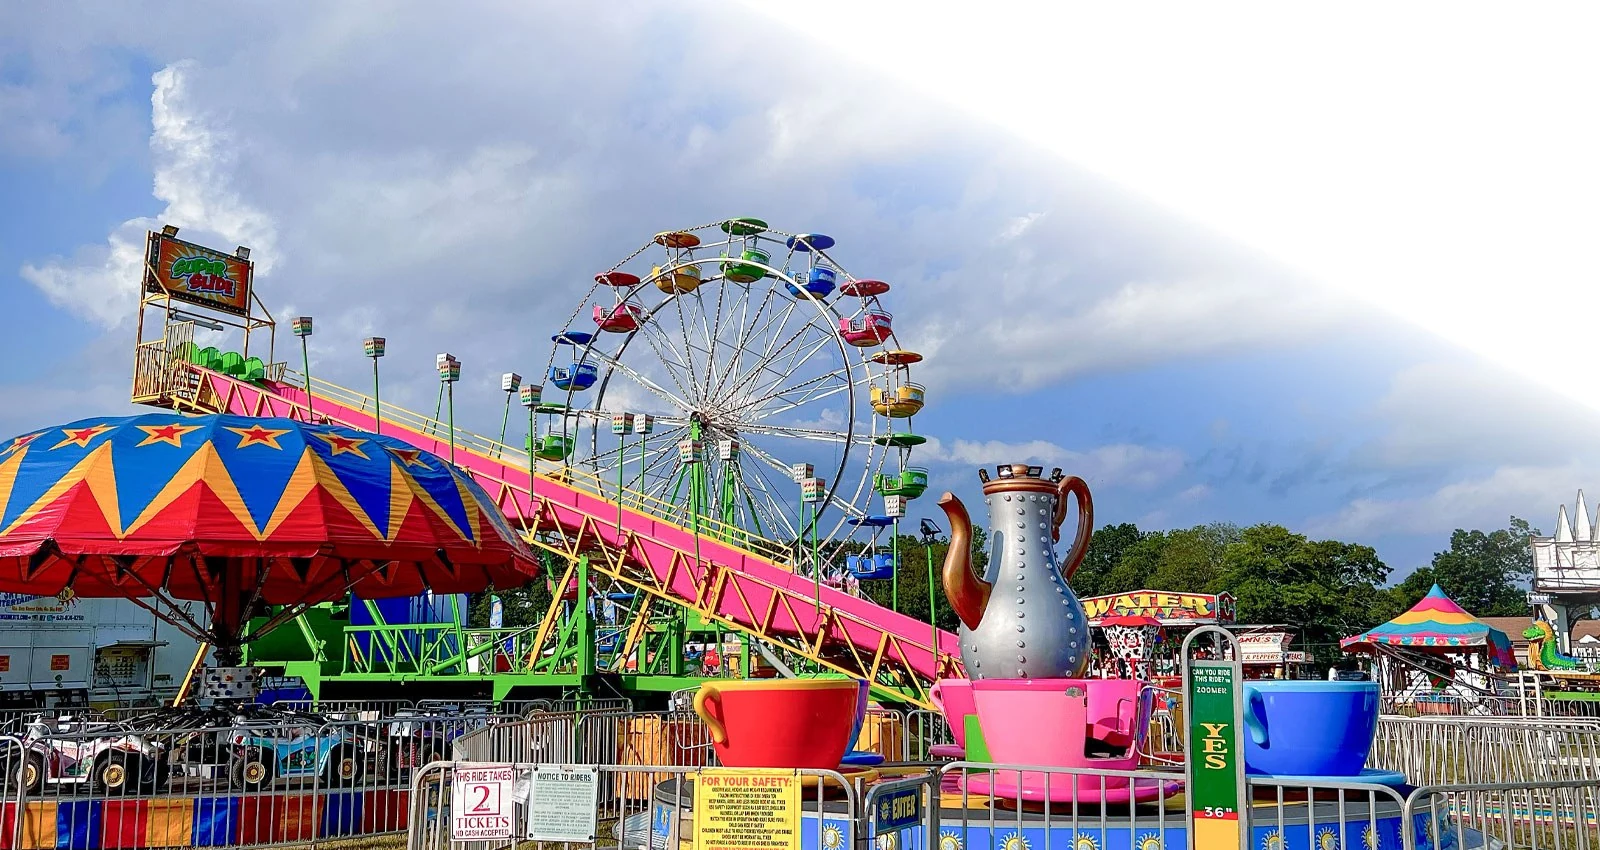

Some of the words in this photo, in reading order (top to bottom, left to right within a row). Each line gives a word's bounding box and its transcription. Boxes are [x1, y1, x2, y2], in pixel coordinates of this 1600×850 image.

[172, 257, 226, 278] SUPER
[188, 273, 234, 295] SLIDE
[1084, 593, 1212, 618] WATER
[1200, 723, 1229, 770] YES
[456, 772, 471, 783] THIS
[472, 771, 488, 782] RIDE
[489, 770, 512, 781] TAKES
[570, 773, 592, 781] RIDERS
[701, 776, 720, 786] FOR
[723, 776, 749, 787] YOUR
[752, 777, 792, 787] SAFETY:
[472, 785, 491, 812] 2
[892, 794, 916, 820] ENTER
[456, 816, 509, 829] TICKETS
[1204, 806, 1233, 818] 36"
